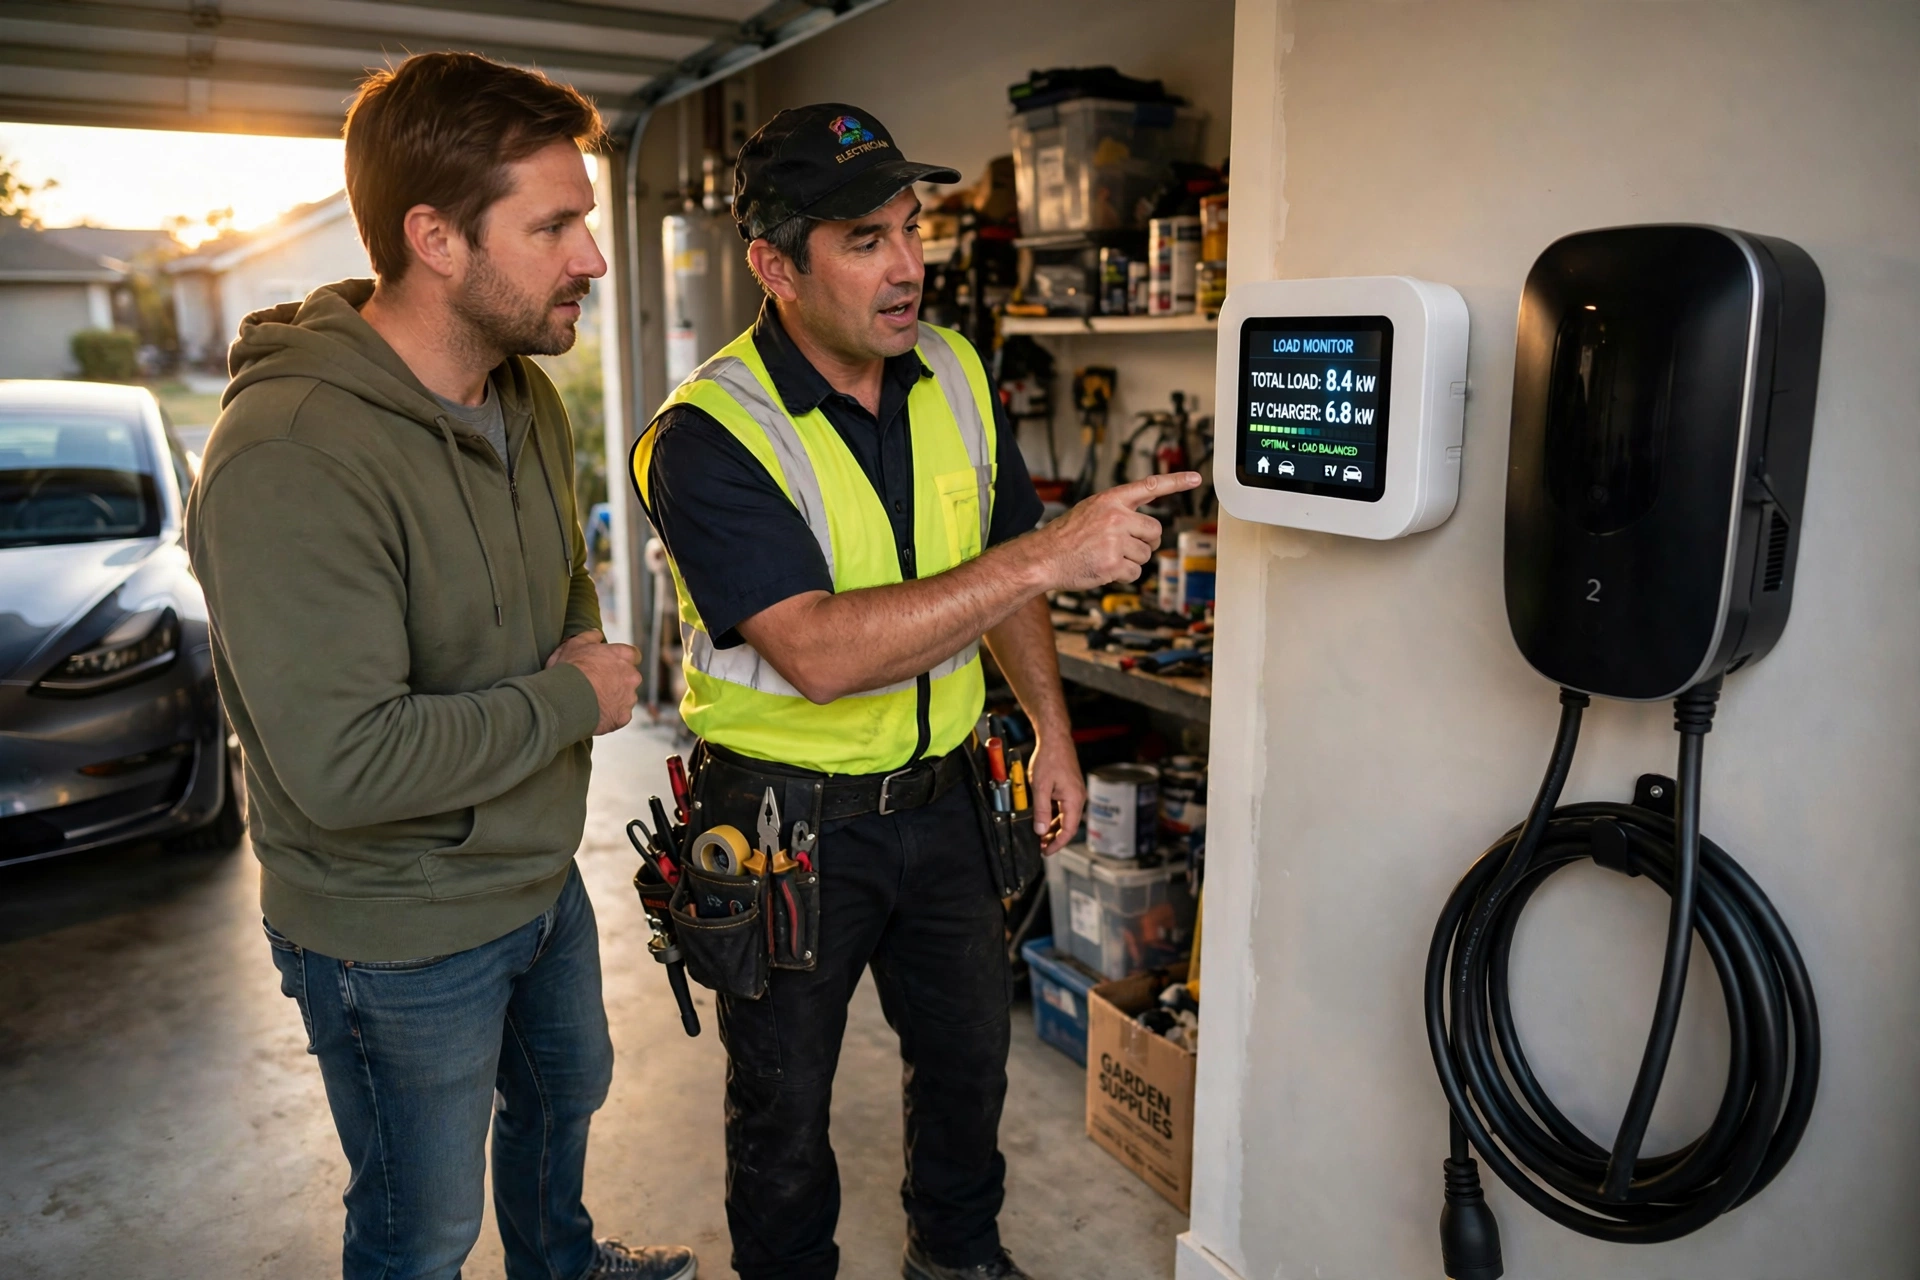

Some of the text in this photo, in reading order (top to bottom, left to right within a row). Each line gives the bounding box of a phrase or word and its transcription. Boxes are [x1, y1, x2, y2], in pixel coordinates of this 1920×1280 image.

[1273, 338, 1354, 354] LOAD MONITOR
[1251, 368, 1376, 393] TOTAL LOAD: 8.4 kW
[1250, 400, 1375, 426] EV CHARGER: 6.8 kW
[1261, 439, 1358, 456] OPTIMAL LOAD BALANCED
[1324, 465, 1338, 477] EV
[1586, 578, 1601, 603] 2
[1101, 1053, 1171, 1116] GARDEN
[1099, 1072, 1173, 1139] SUPPLIES
